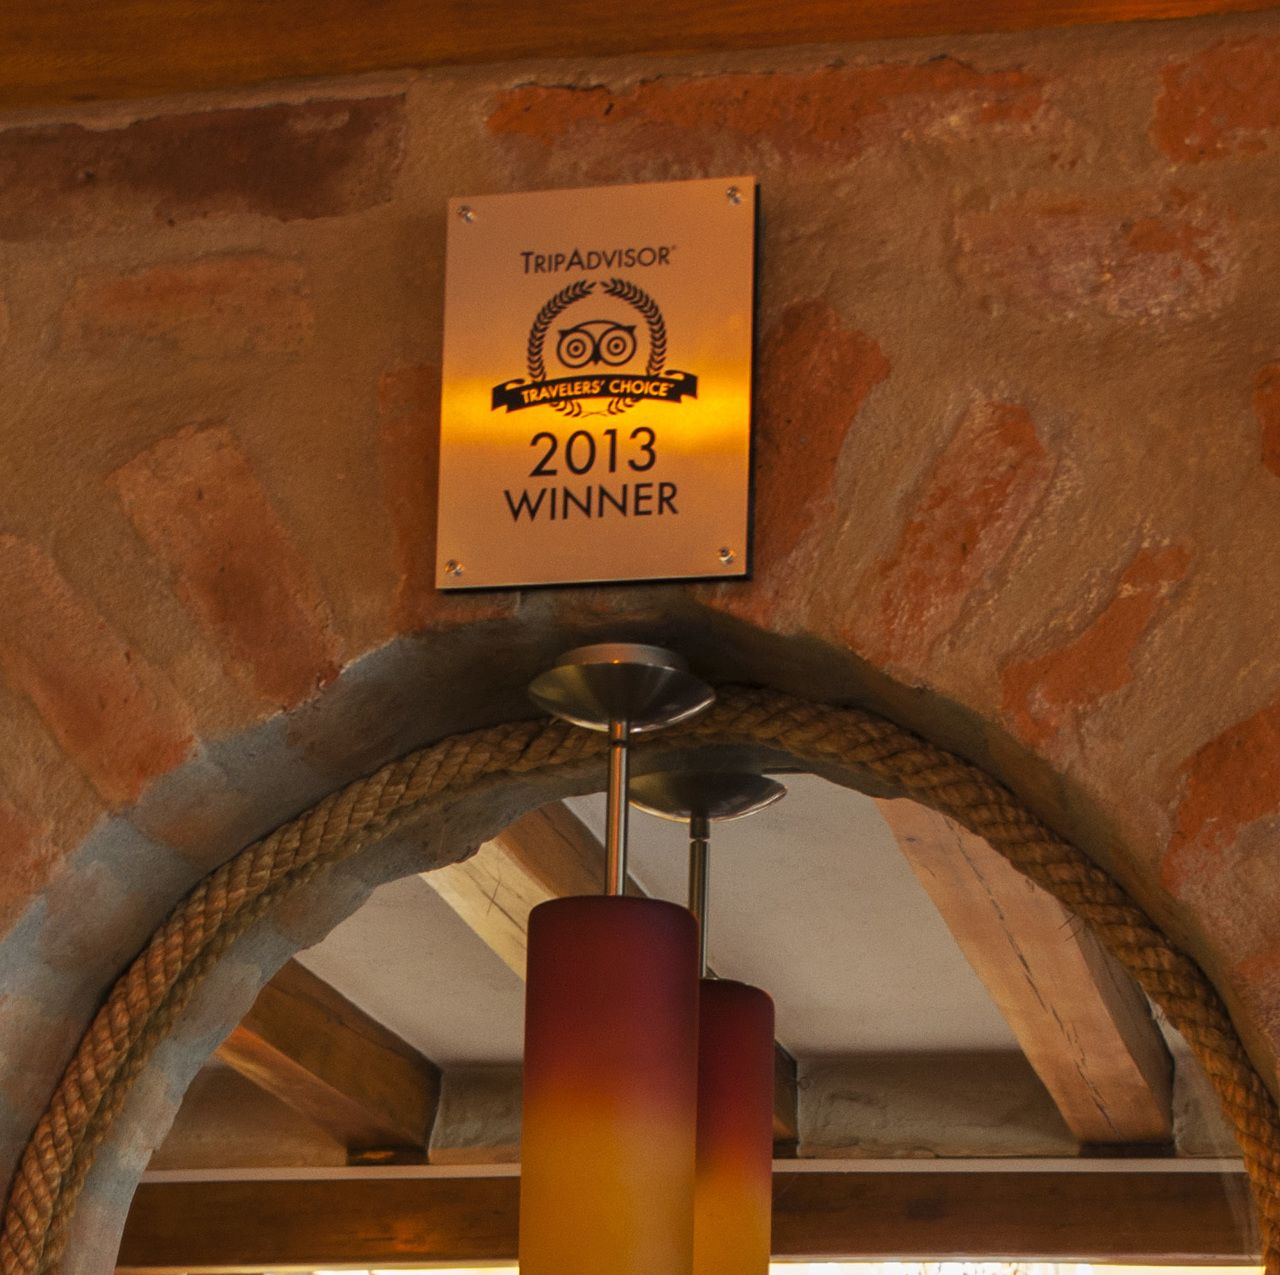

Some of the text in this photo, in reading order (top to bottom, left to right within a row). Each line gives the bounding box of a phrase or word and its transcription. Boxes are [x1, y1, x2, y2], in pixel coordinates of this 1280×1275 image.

[521, 379, 670, 405] TRAVELERS' CHOICE
[529, 426, 657, 478] 2013
[503, 481, 679, 522] WINNER
